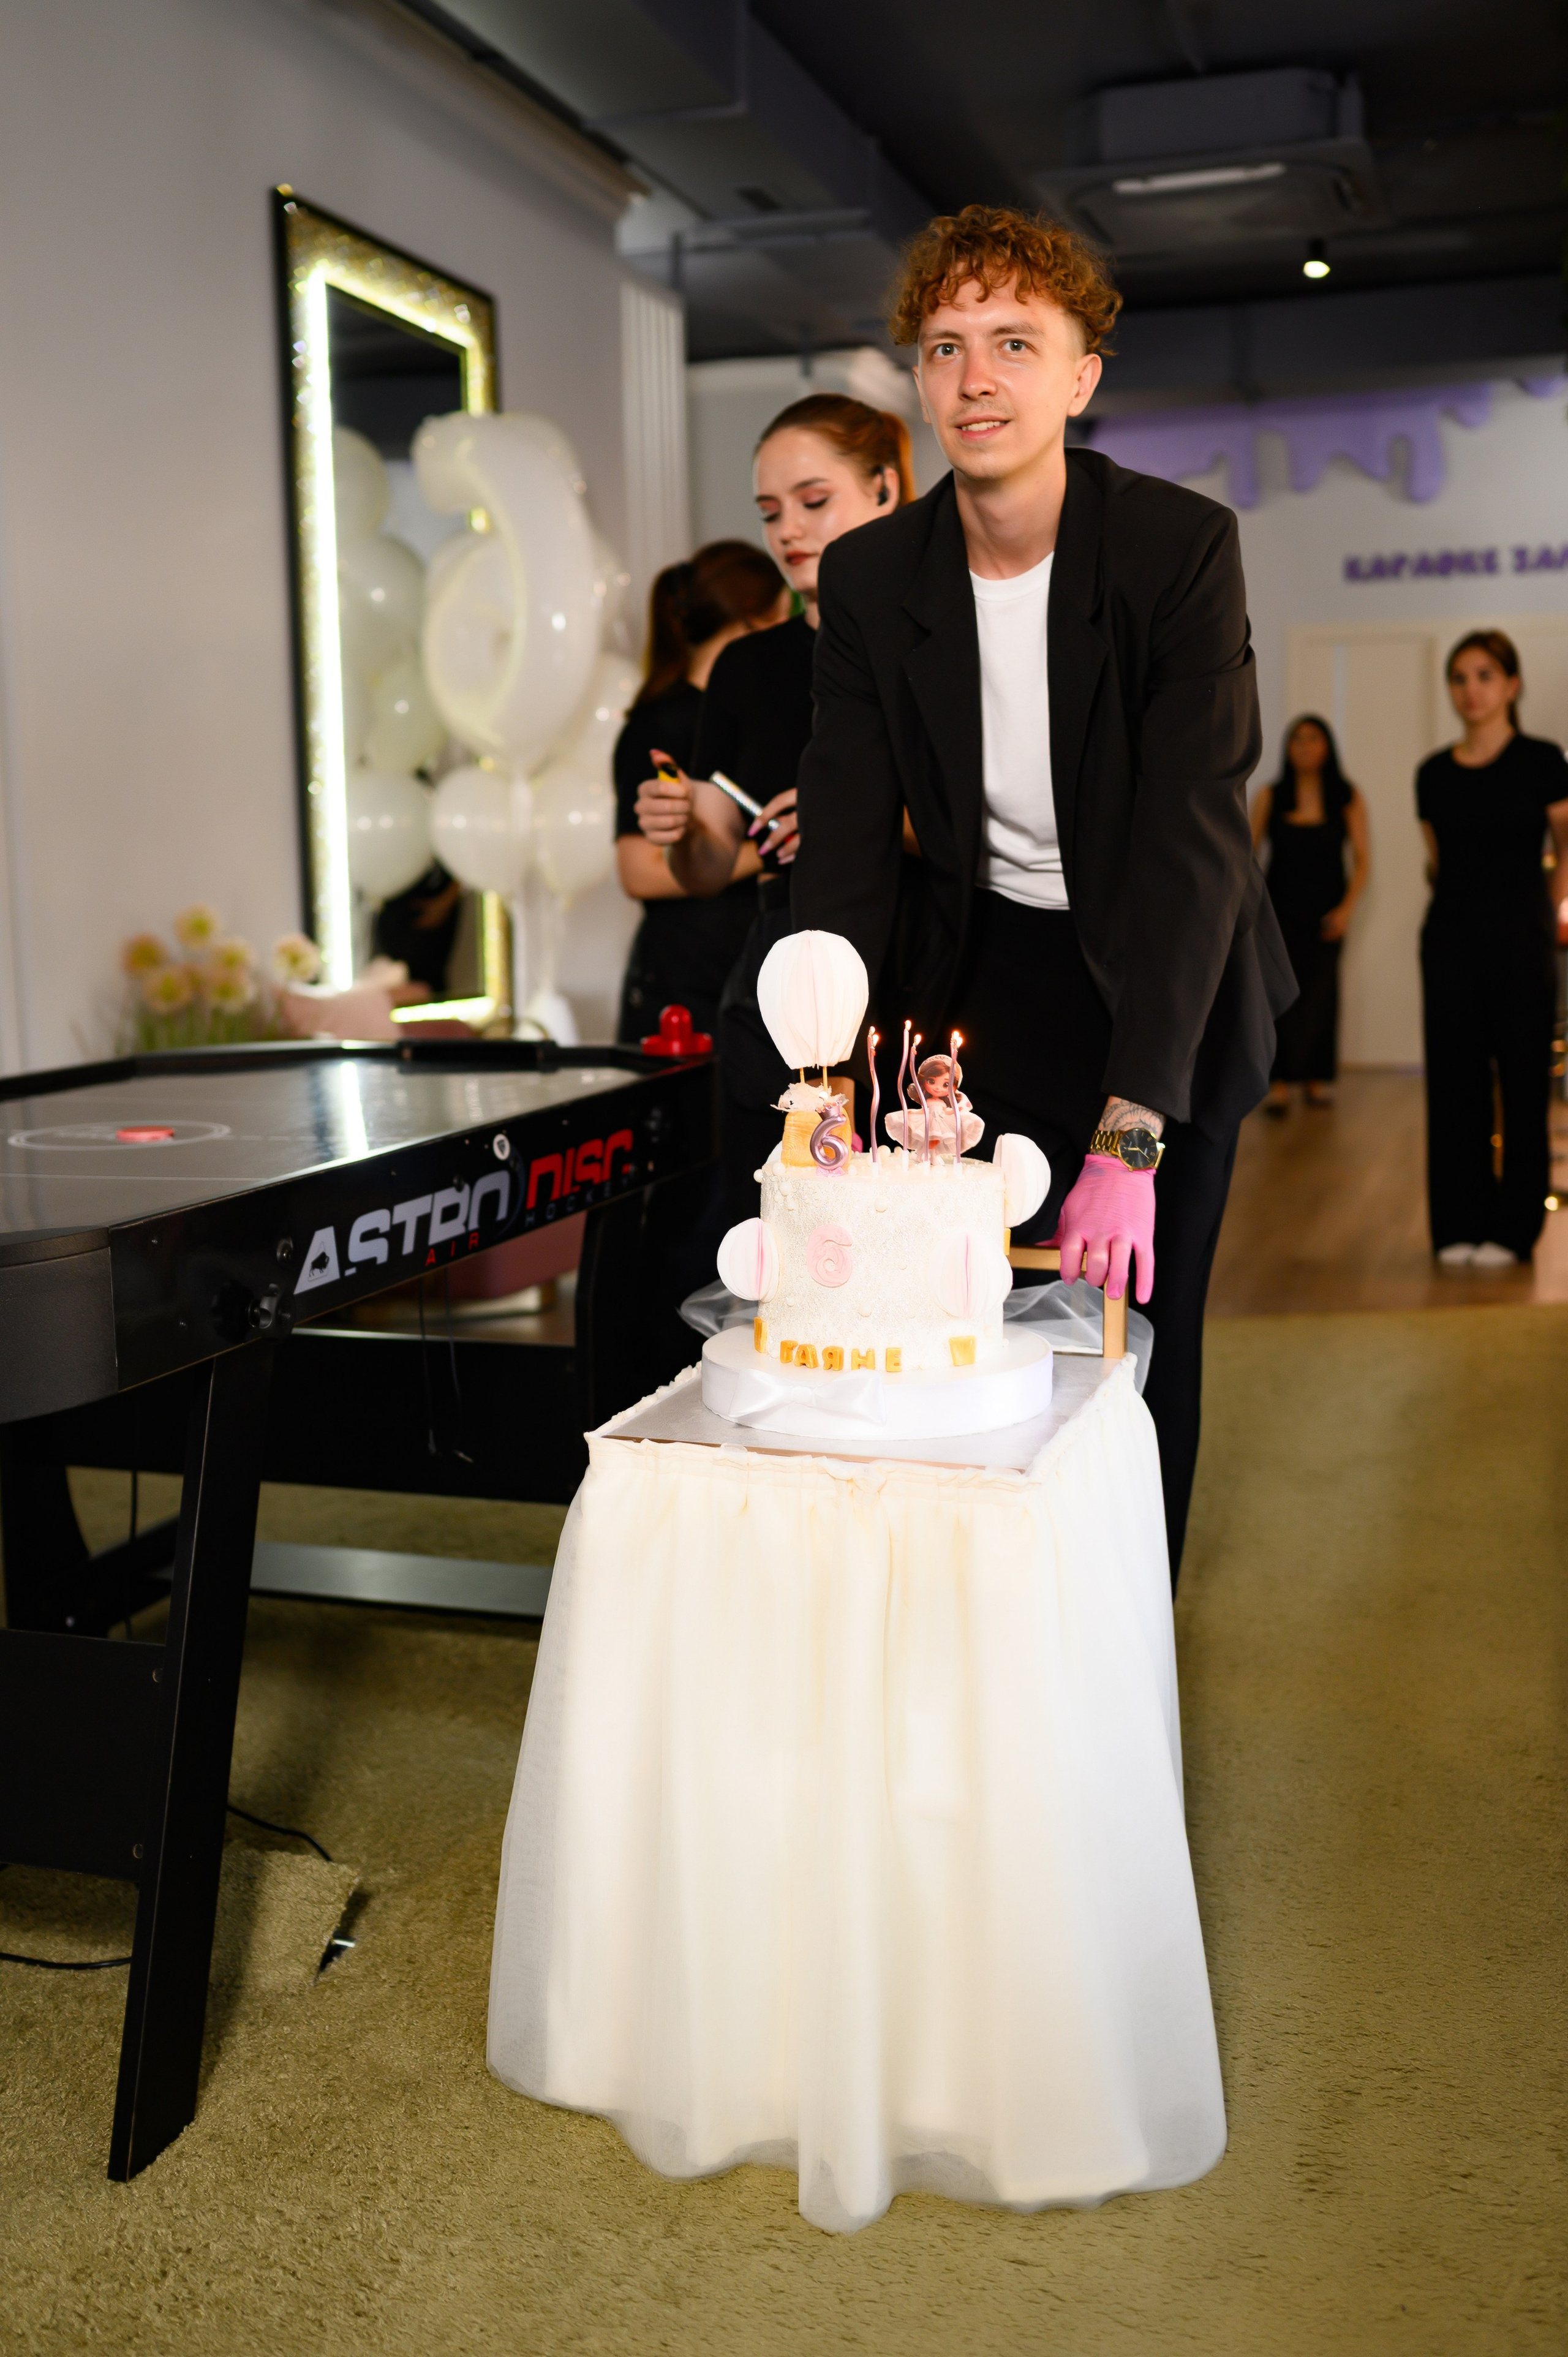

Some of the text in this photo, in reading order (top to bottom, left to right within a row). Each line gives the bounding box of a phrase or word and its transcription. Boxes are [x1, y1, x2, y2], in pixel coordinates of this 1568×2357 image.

[809, 1109, 850, 1170] 6
[293, 1128, 633, 1295] ASTRO DISC
[425, 1231, 479, 1266] AIR
[807, 1224, 853, 1288] 6
[780, 1340, 902, 1372] ГАЯНЕ
